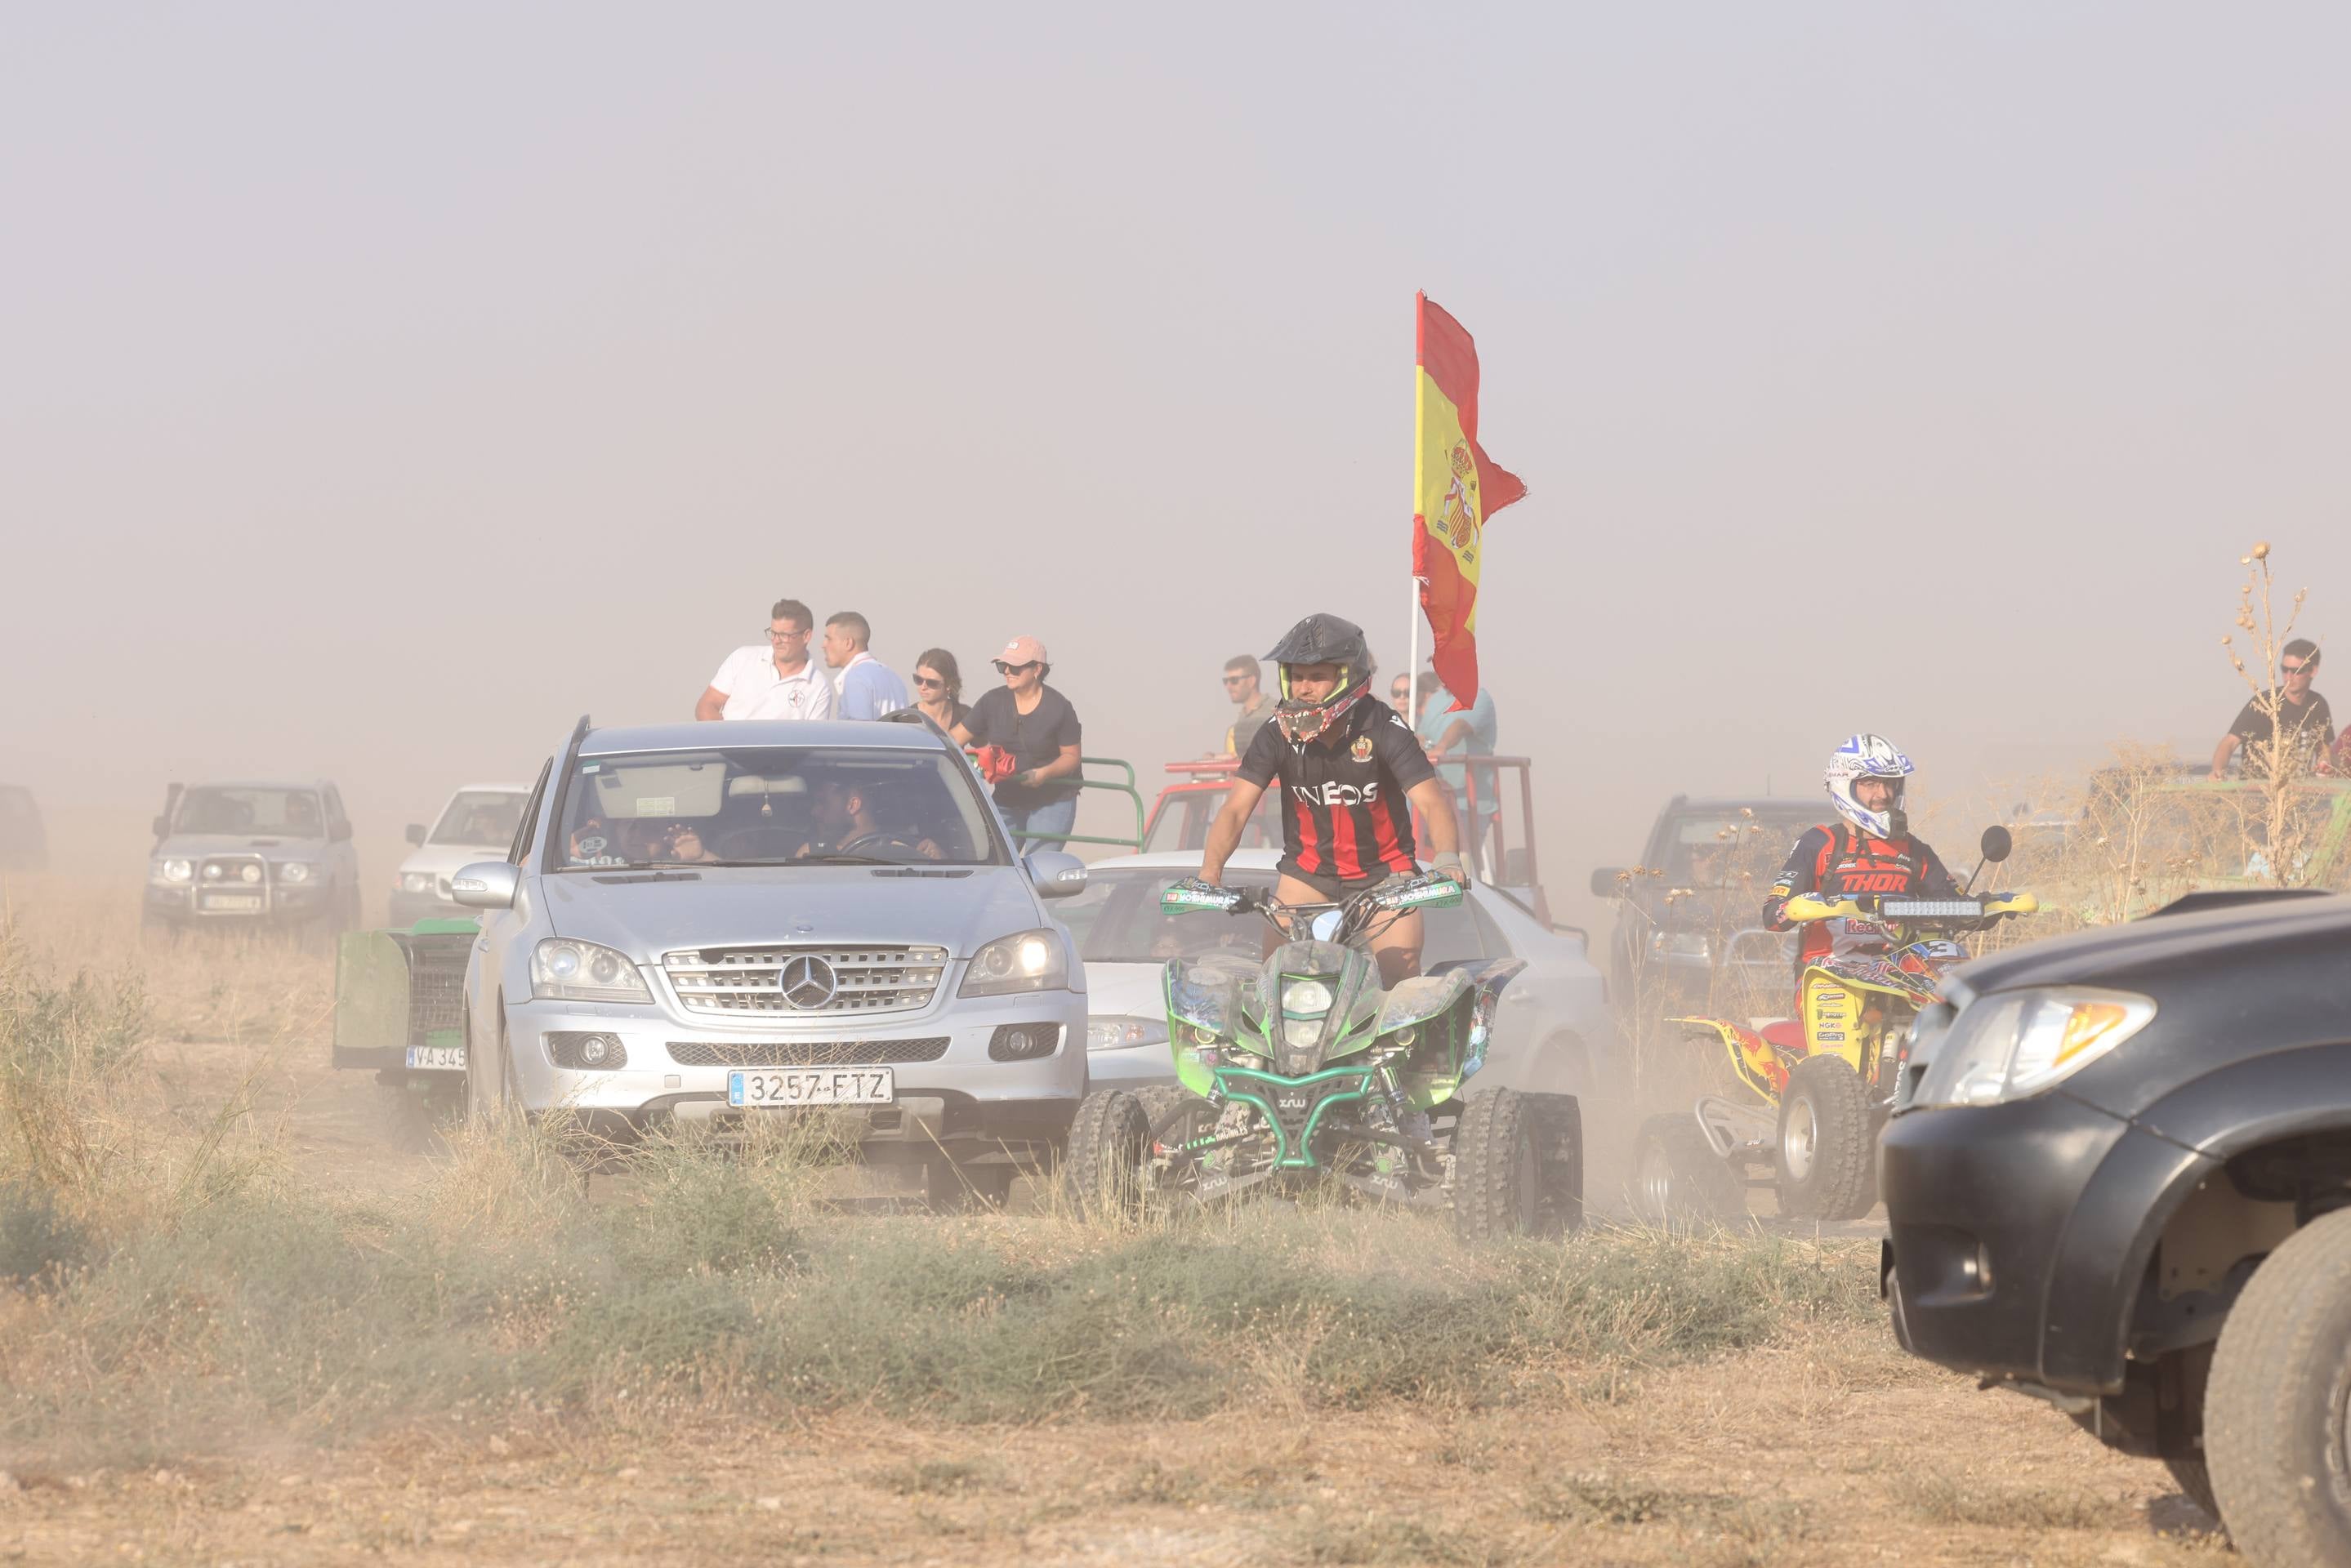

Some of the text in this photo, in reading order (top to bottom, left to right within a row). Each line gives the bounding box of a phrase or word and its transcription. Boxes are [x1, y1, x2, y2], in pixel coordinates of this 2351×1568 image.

[1291, 781, 1378, 808] INEOS
[1842, 874, 1908, 893] THOR
[750, 1073, 884, 1101] 3257 FTZ
